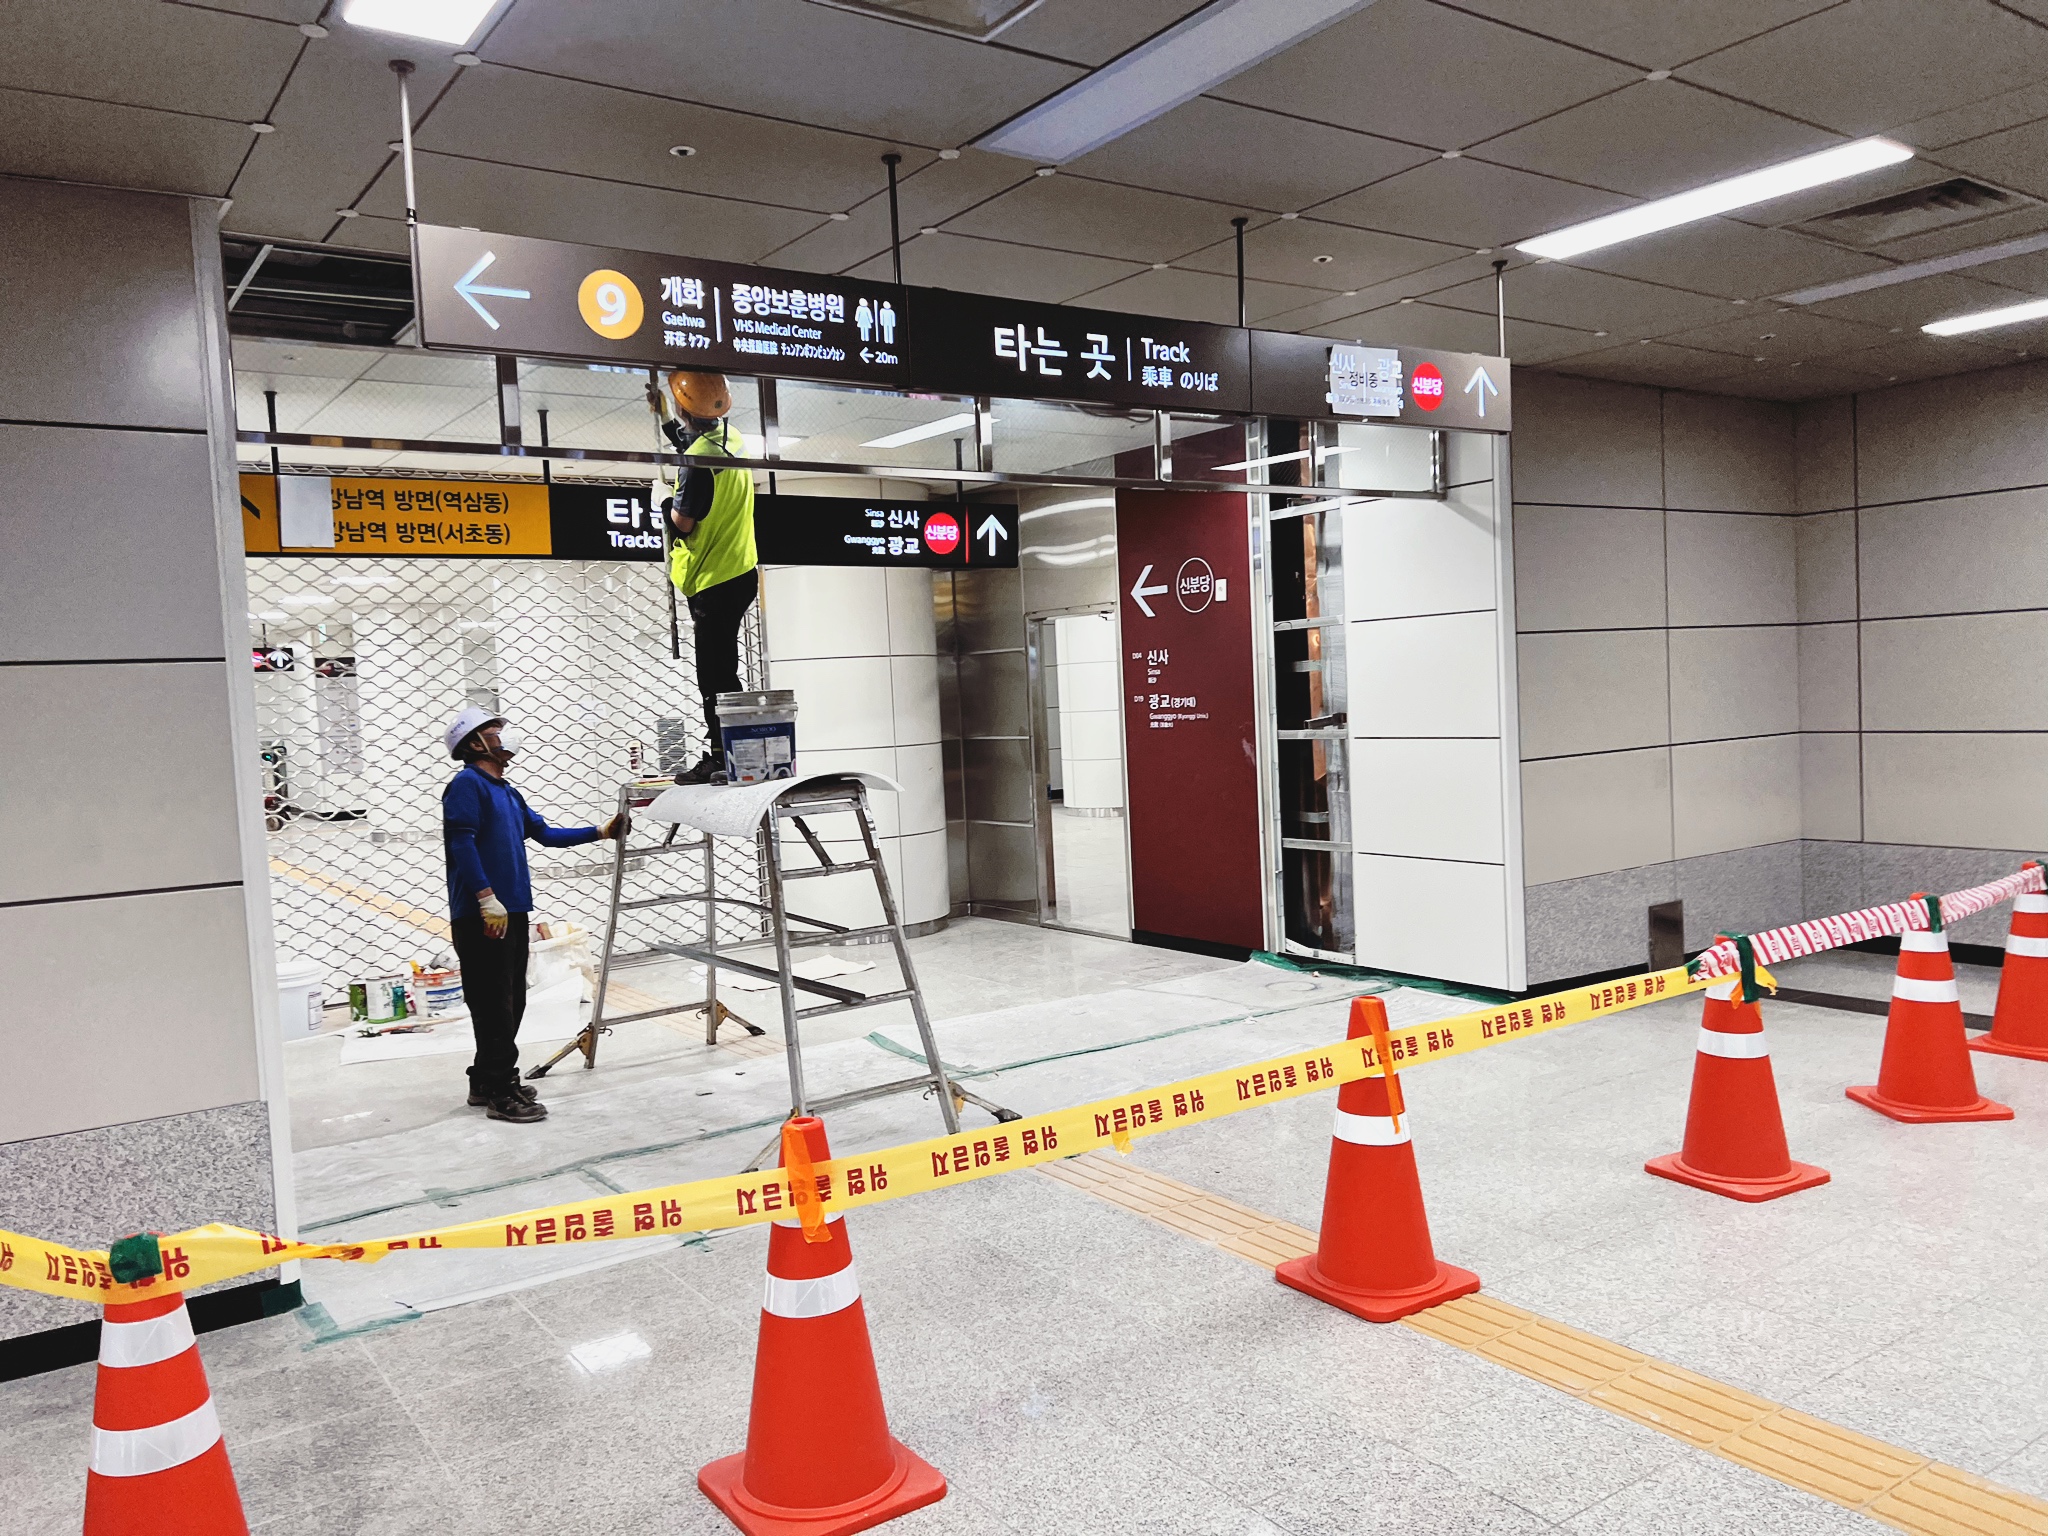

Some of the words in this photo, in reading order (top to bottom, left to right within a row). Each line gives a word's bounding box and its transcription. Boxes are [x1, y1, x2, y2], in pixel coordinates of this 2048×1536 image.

[596, 283, 627, 326] 9
[661, 276, 705, 309] 개화
[731, 283, 845, 323] 중앙보훈병원
[662, 311, 706, 328] Gaehwa
[733, 318, 753, 332] VHS
[754, 321, 791, 337] Medical
[792, 324, 822, 340] Center
[875, 350, 899, 365] 20m
[994, 323, 1068, 376] 타는
[1080, 333, 1116, 381] 곳
[1141, 337, 1191, 364] Track
[1180, 371, 1219, 392] のりば
[1411, 376, 1443, 396] 신분당
[394, 490, 509, 514] 방면(역삼동)
[864, 508, 885, 518] Sinsa
[887, 509, 920, 529] 신사
[396, 522, 510, 545] 방면(서초동)
[606, 530, 663, 548] Tracks
[887, 535, 921, 556] 광교
[925, 525, 959, 541] 신분당
[1179, 574, 1211, 595] 신분당
[1147, 648, 1170, 666] 신사
[1589, 982, 1637, 1011] 출입금지
[1644, 975, 1665, 996] 위험
[1481, 1008, 1534, 1039] 출입금지
[1541, 1001, 1566, 1024] 위험
[1426, 1028, 1454, 1053] 위험
[1306, 1057, 1335, 1083] 위험
[1236, 1065, 1297, 1101] 출입금지
[1172, 1089, 1205, 1118] 위험
[1094, 1099, 1163, 1138] 출입금지
[1021, 1125, 1058, 1156] 위험
[931, 1135, 1010, 1178] 출입금지
[847, 1163, 888, 1197] 위험
[506, 1209, 615, 1247] 출입금지
[633, 1199, 682, 1232] 위험
